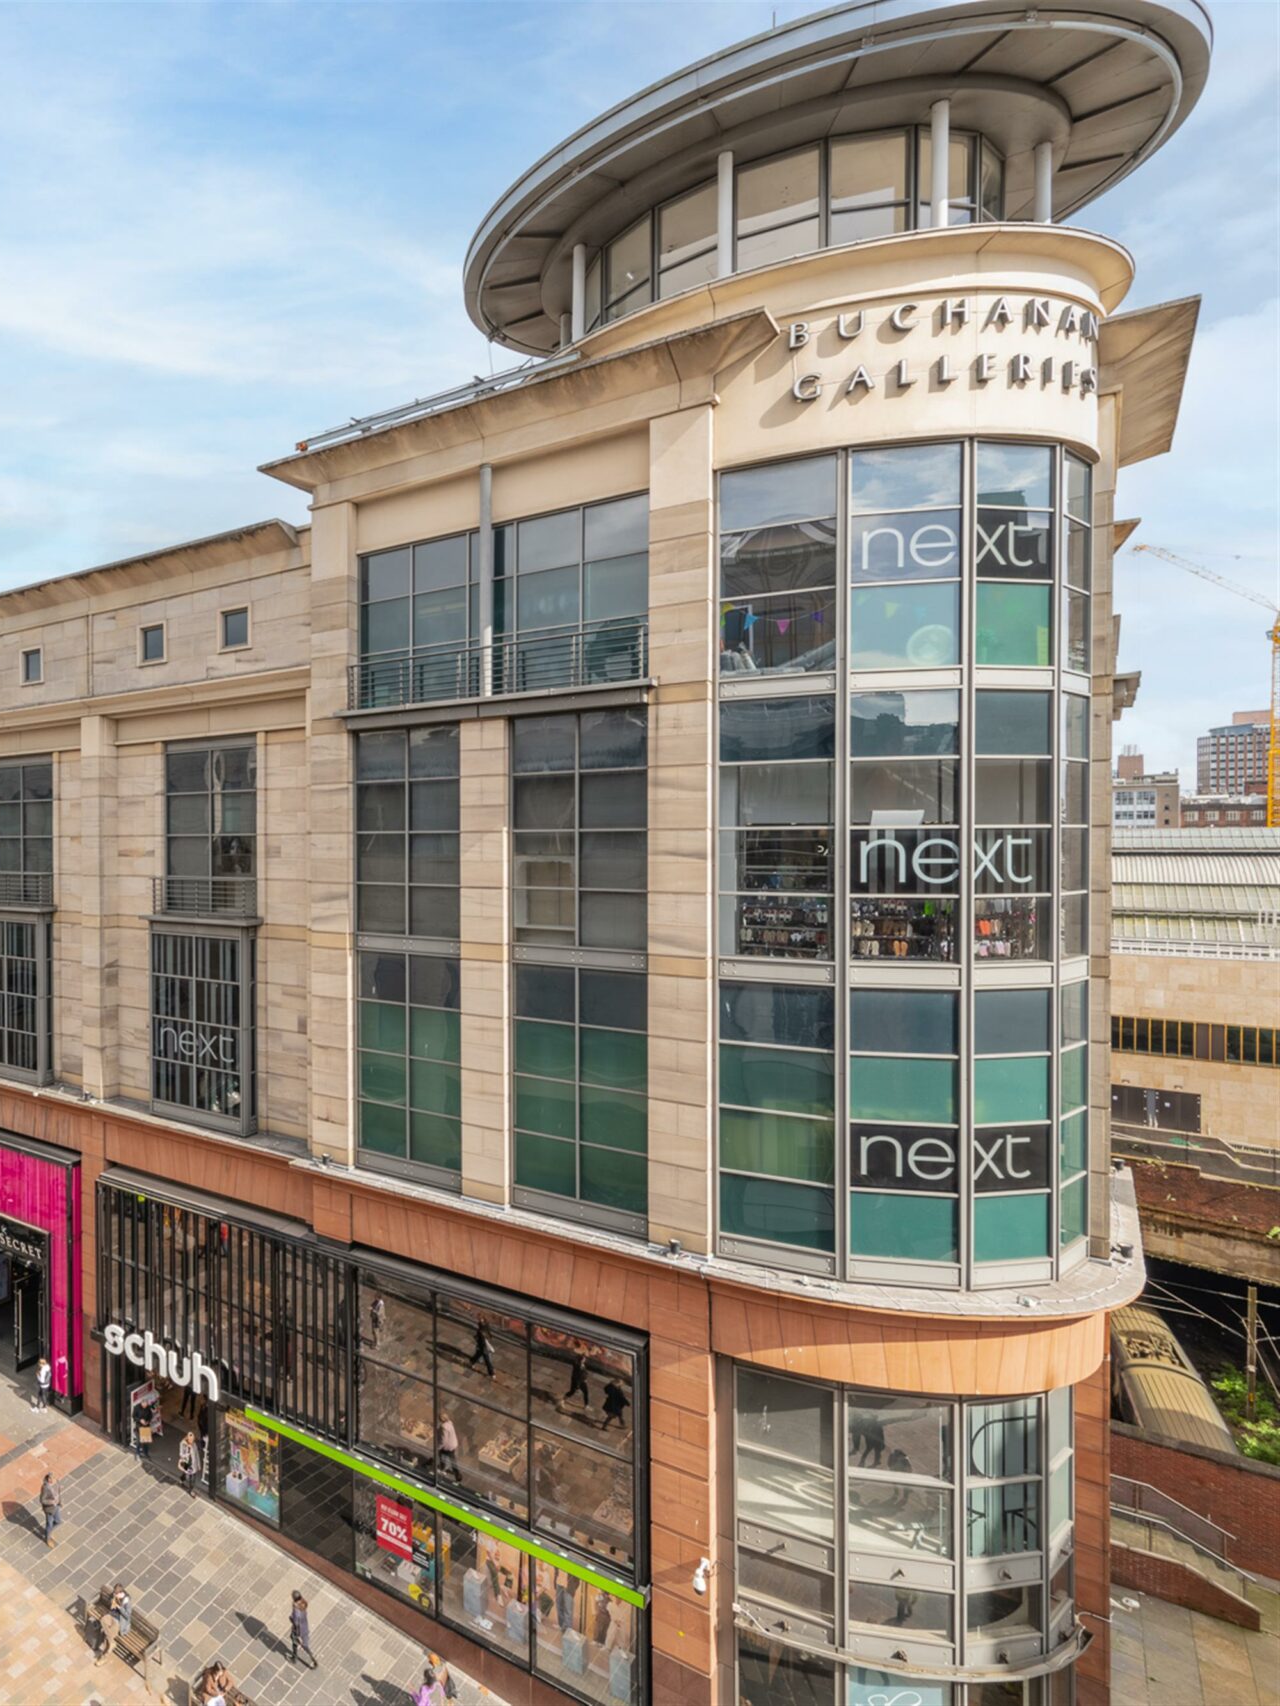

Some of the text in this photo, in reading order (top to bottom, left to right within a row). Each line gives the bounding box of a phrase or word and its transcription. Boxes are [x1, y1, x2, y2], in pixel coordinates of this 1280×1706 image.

[788, 296, 1099, 350] BUCHANAN
[792, 353, 1097, 400] GALLERIES
[861, 521, 1034, 571] next
[859, 834, 1033, 885] next
[160, 1026, 234, 1063] next
[859, 1134, 1032, 1181] next
[104, 1323, 219, 1402] schuh
[380, 1516, 409, 1542] 70%
